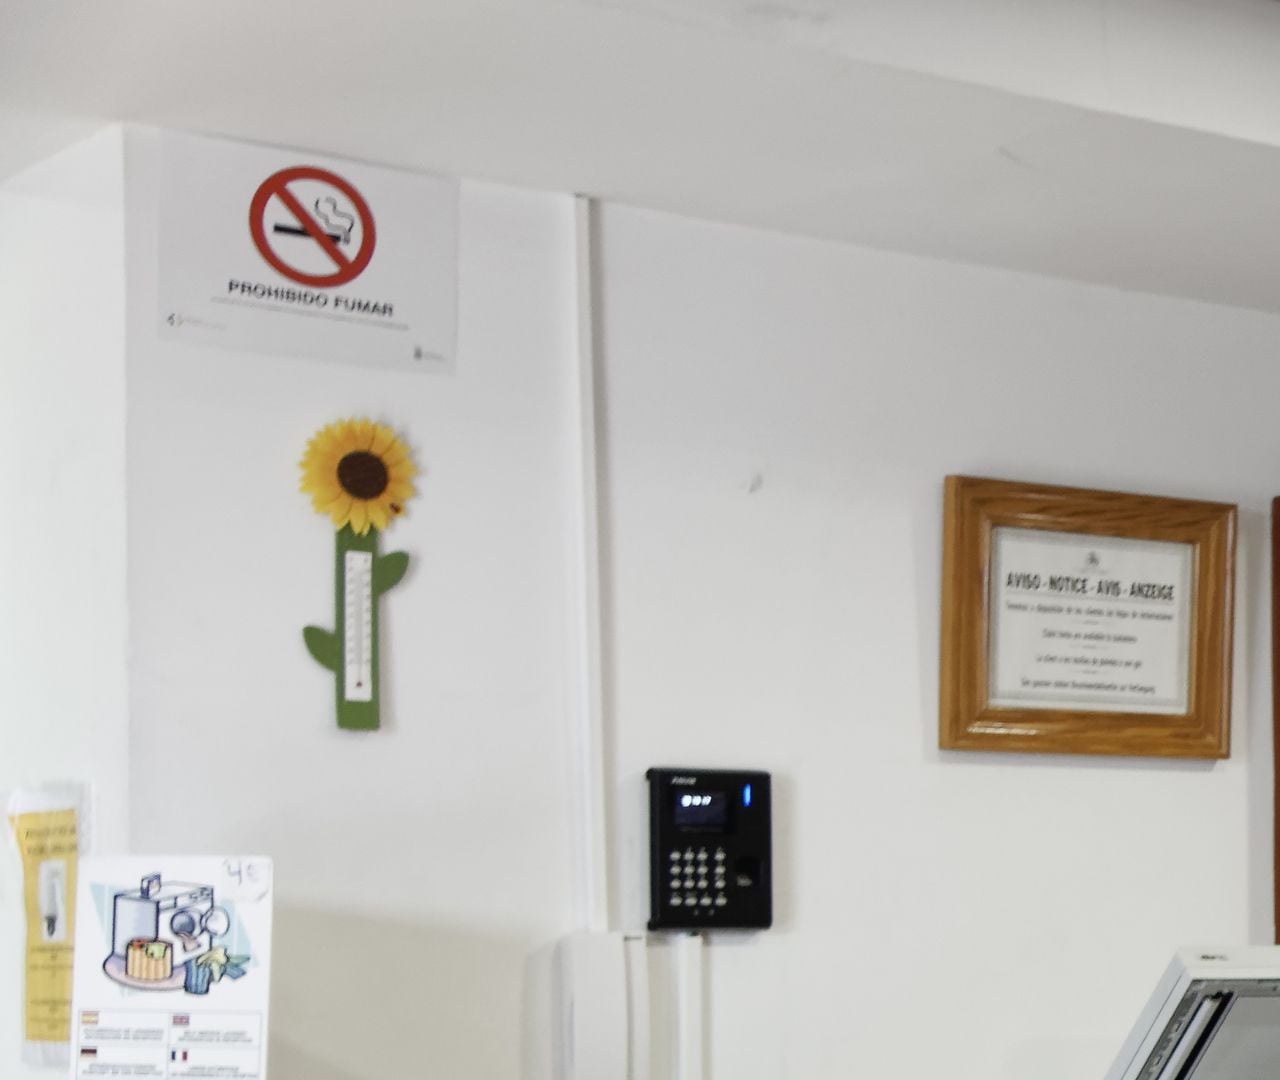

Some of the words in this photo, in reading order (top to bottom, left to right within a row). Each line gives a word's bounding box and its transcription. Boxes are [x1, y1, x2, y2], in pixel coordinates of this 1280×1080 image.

[228, 279, 329, 307] PROHIBIDO
[333, 295, 395, 317] FUMAR
[1007, 572, 1041, 590] AVISO
[1048, 574, 1089, 594] NOTICE
[1096, 579, 1121, 597] AVIS
[1129, 582, 1176, 600] ANZEIGE
